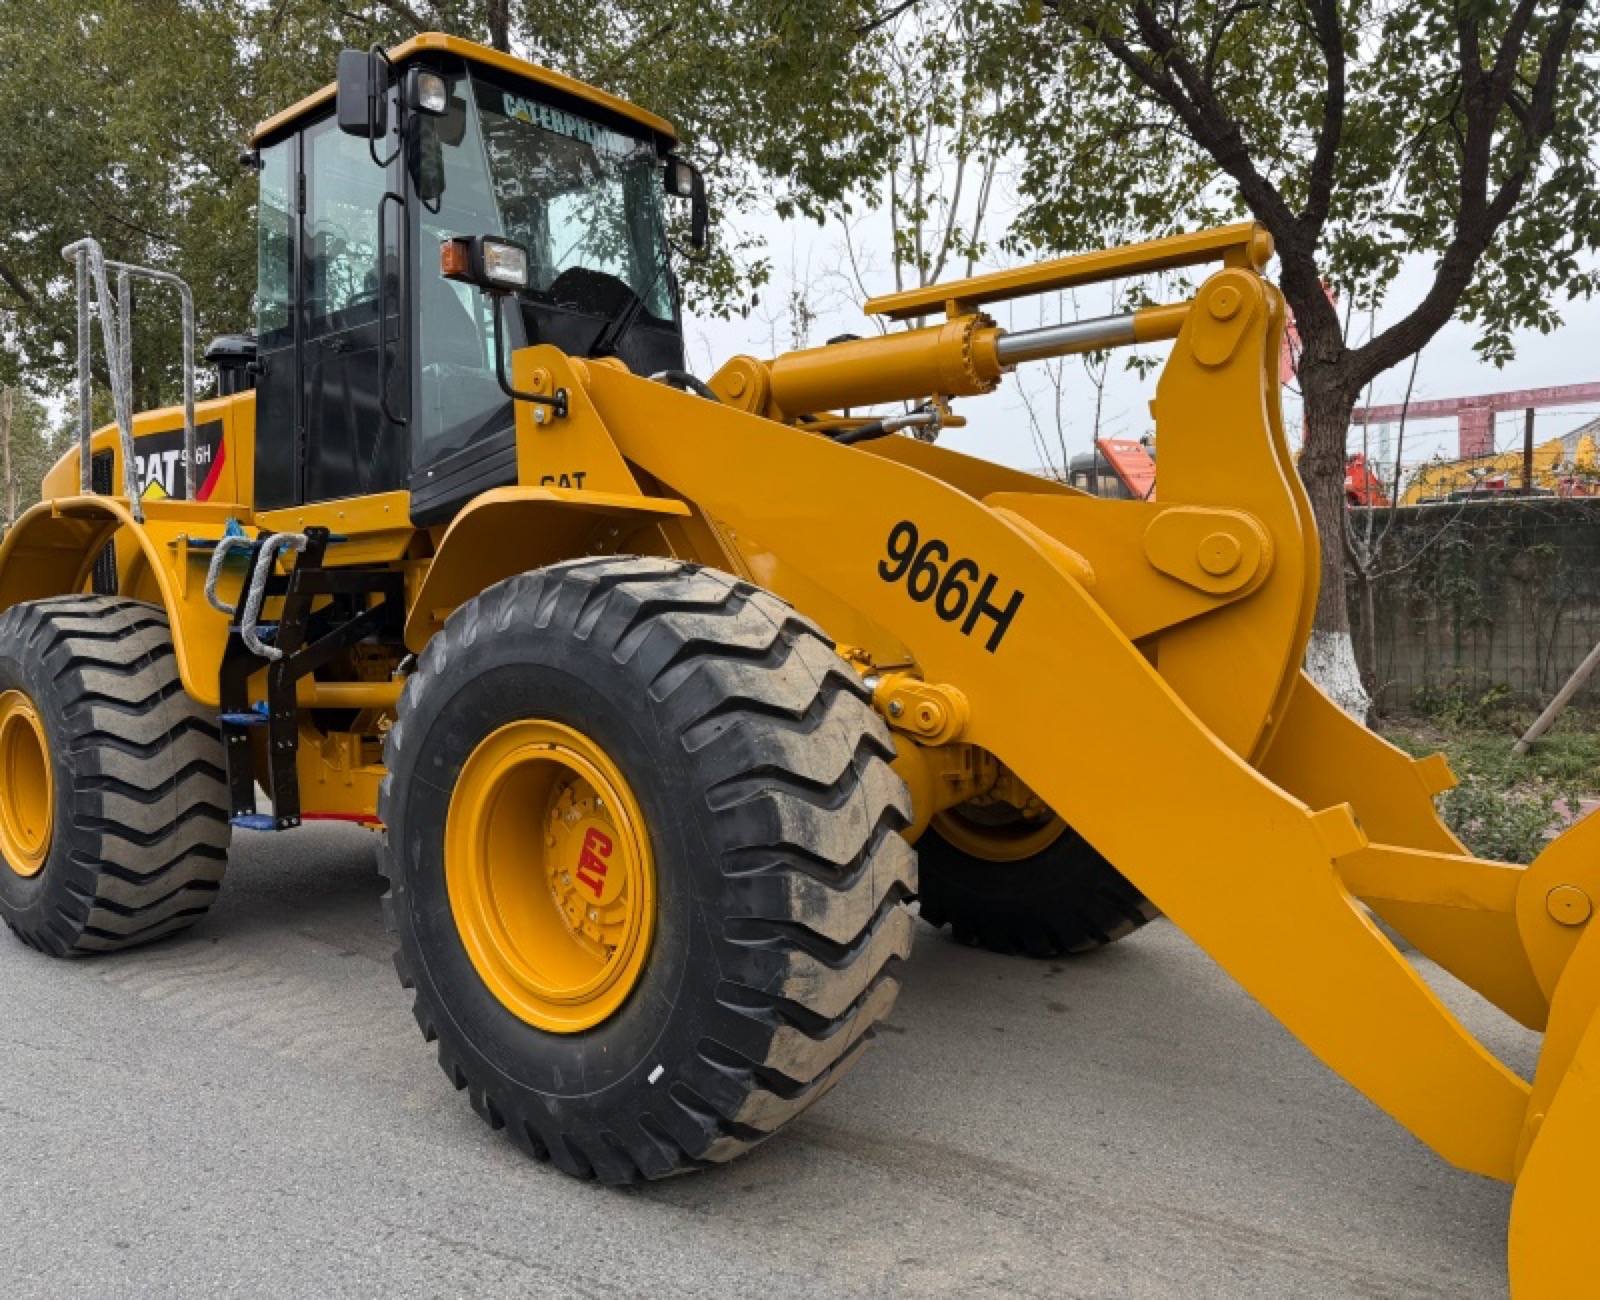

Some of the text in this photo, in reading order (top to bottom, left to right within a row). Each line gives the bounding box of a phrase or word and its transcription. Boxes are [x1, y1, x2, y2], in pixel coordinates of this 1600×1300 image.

[180, 444, 211, 467] 96H
[878, 520, 1024, 654] 966H
[576, 826, 612, 898] CAT
